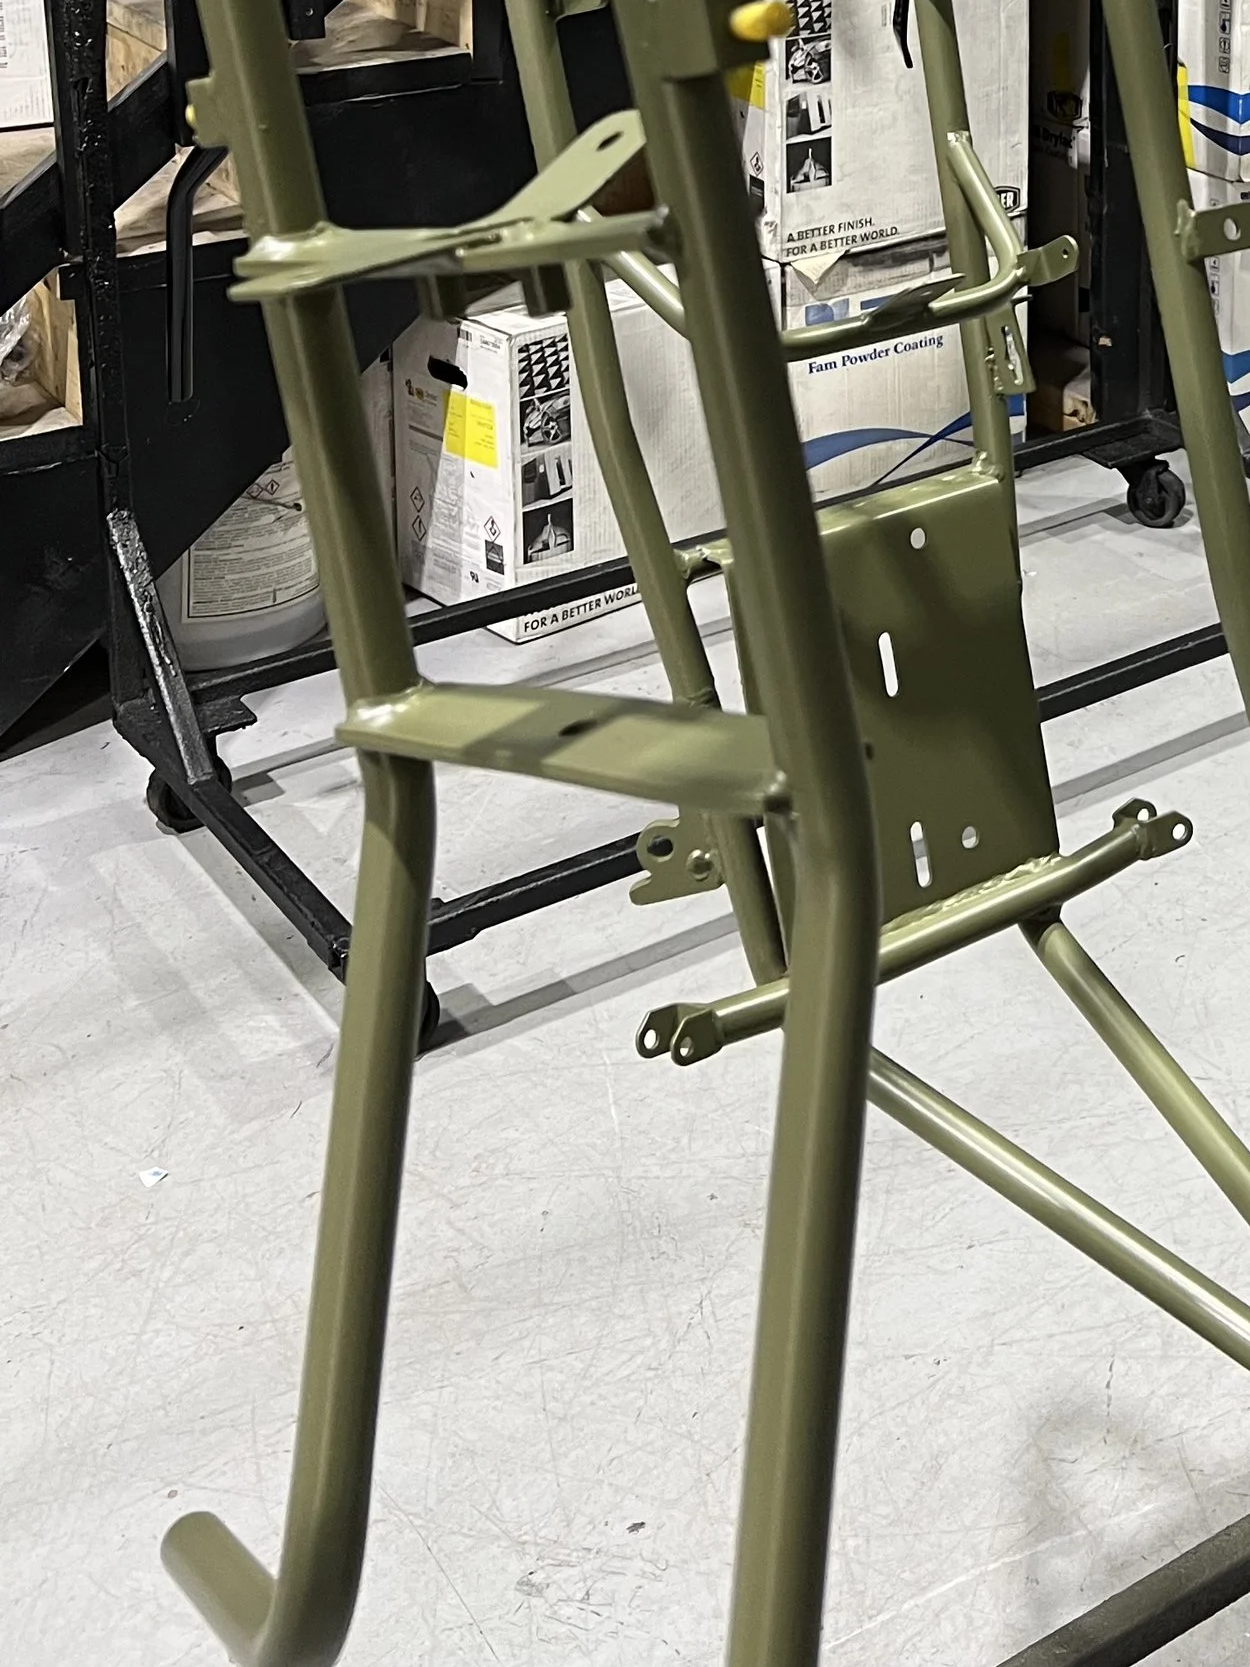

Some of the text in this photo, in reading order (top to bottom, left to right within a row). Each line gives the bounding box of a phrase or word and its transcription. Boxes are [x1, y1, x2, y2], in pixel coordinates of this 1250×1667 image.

[787, 217, 875, 242] A BETTER FINISH.
[786, 245, 807, 257] FOR
[810, 243, 818, 253] A
[820, 235, 857, 250] BETTER
[808, 335, 944, 374] Fam Powder Coating
[524, 586, 637, 633] FOR A BETTER WORL
